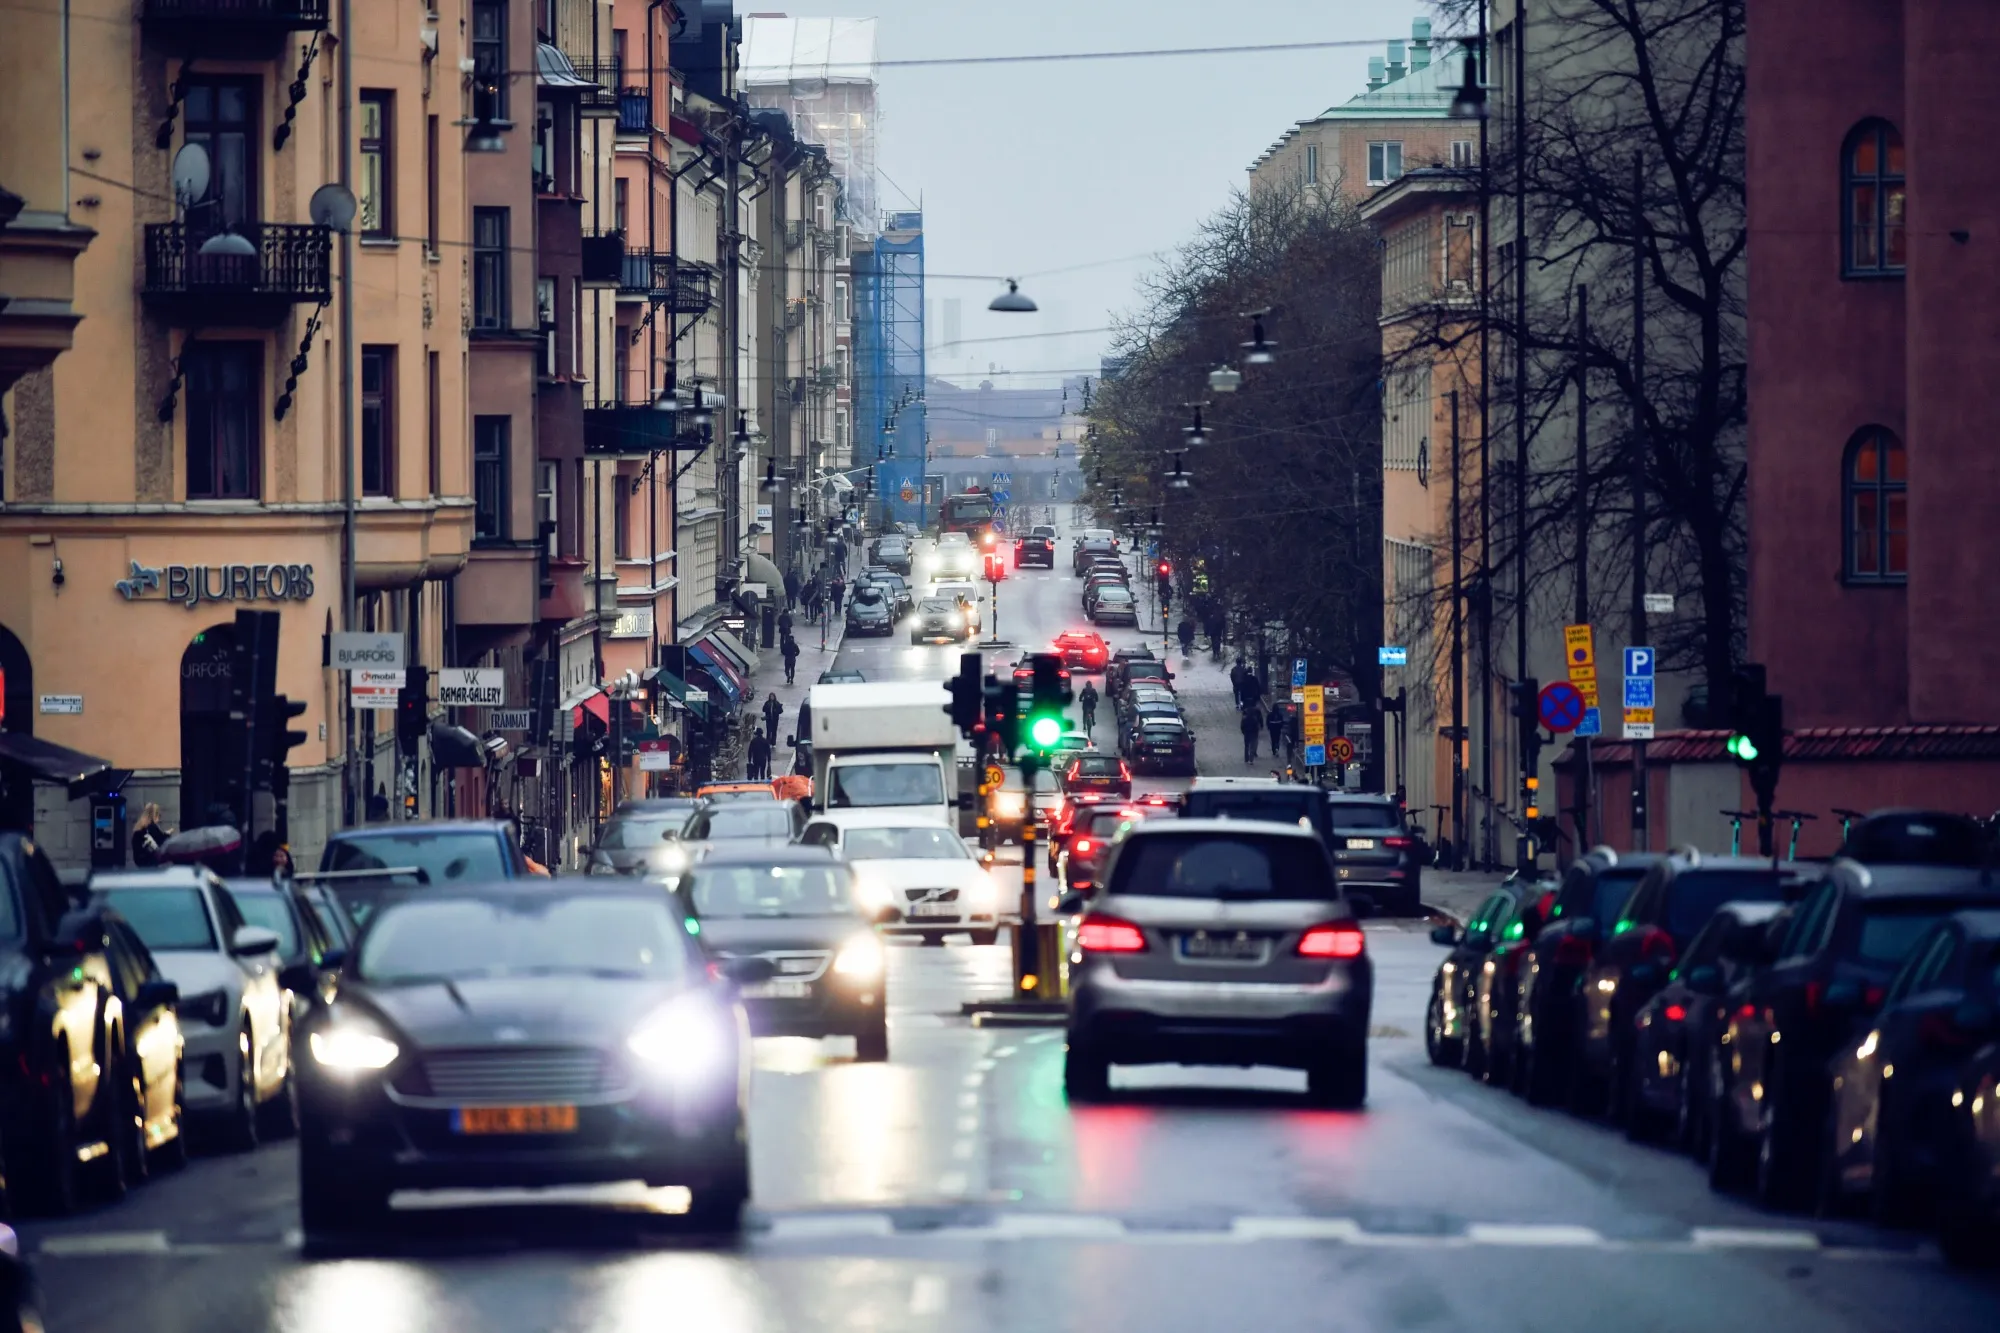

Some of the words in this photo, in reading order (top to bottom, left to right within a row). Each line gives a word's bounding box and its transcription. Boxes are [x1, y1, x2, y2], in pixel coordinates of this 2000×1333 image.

[168, 564, 314, 607] BJURFORS
[338, 648, 396, 663] BJURFORS
[1631, 651, 1649, 674] P
[1296, 660, 1304, 670] P
[440, 687, 502, 703] RAMAR-GALLERY
[1331, 743, 1350, 758] 50
